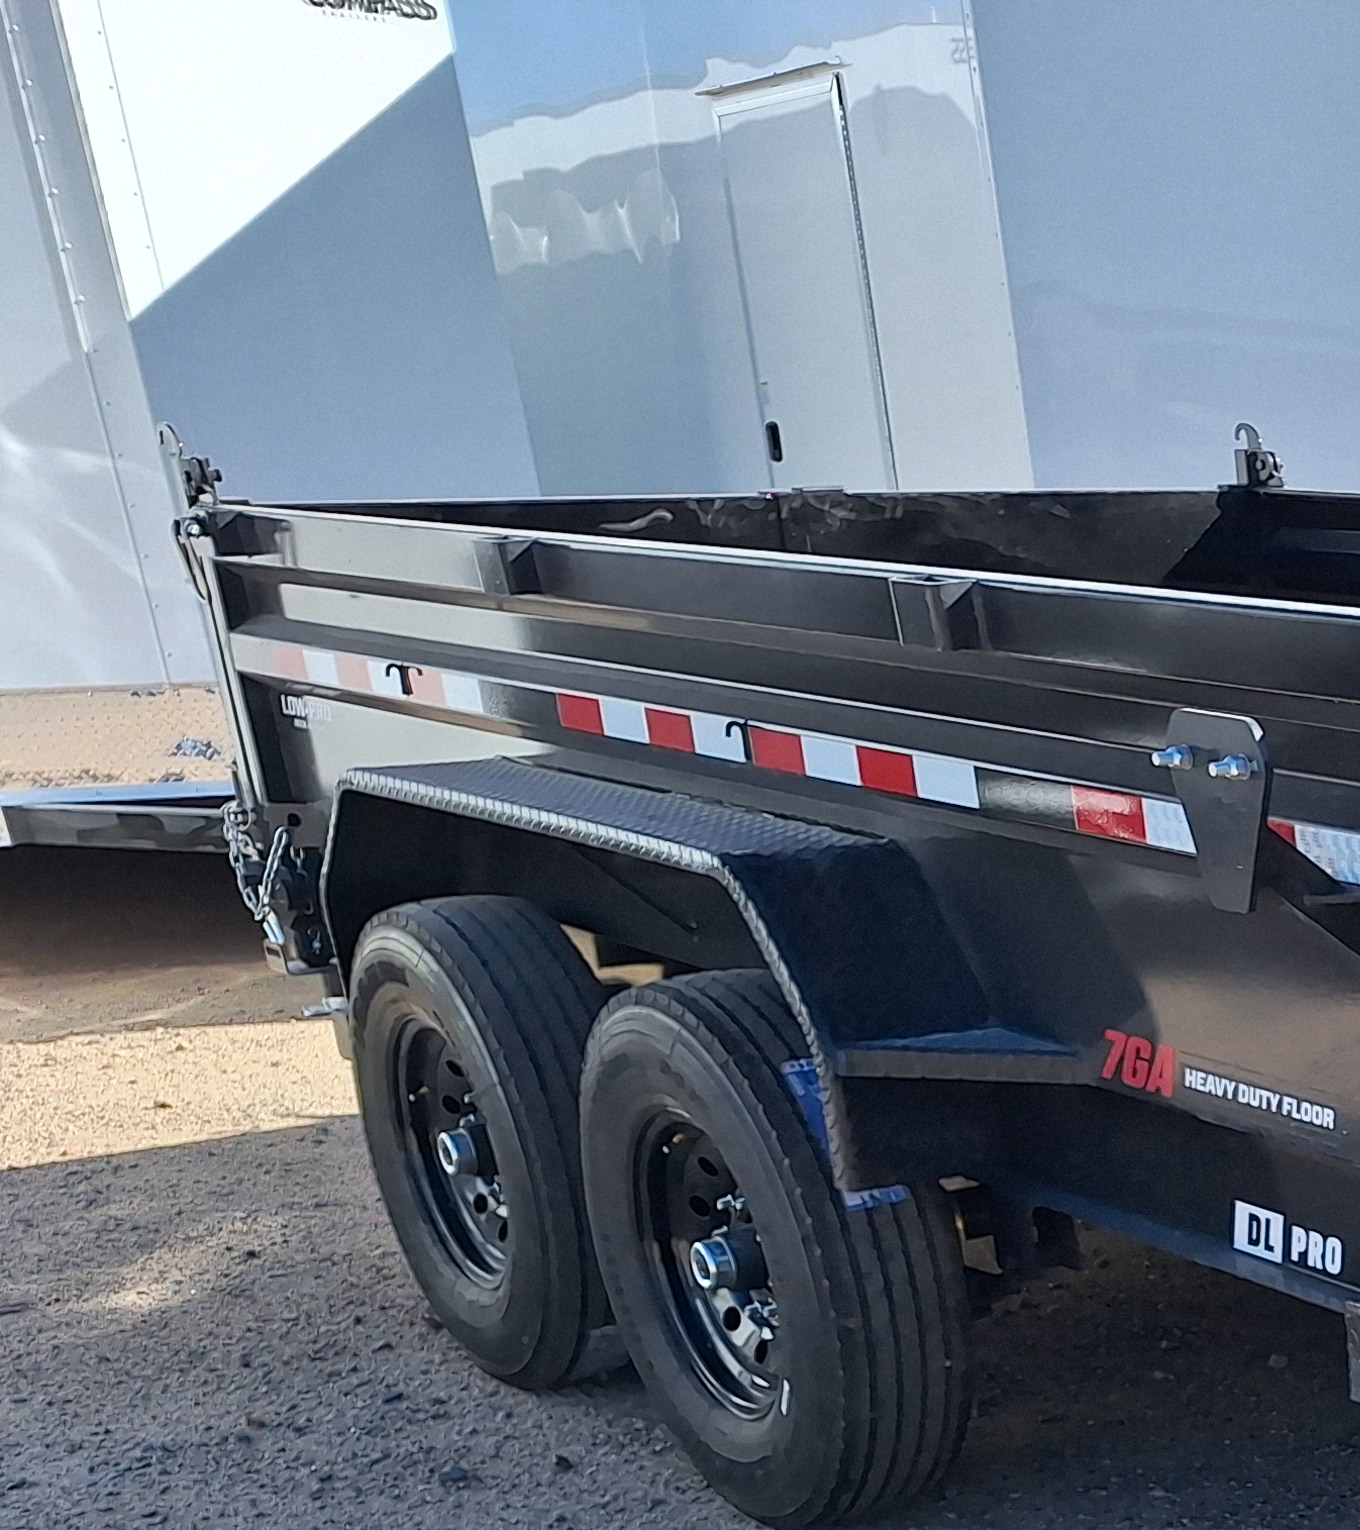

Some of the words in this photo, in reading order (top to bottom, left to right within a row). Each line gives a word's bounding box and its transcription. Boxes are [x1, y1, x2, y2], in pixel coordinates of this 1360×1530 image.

[1101, 1029, 1175, 1097] 7GA
[1184, 1066, 1237, 1101] HEAVY
[1237, 1083, 1281, 1113] DUTY
[1281, 1096, 1335, 1130] FLOOR
[1247, 1211, 1276, 1254] DL
[1290, 1224, 1342, 1275] PRO
